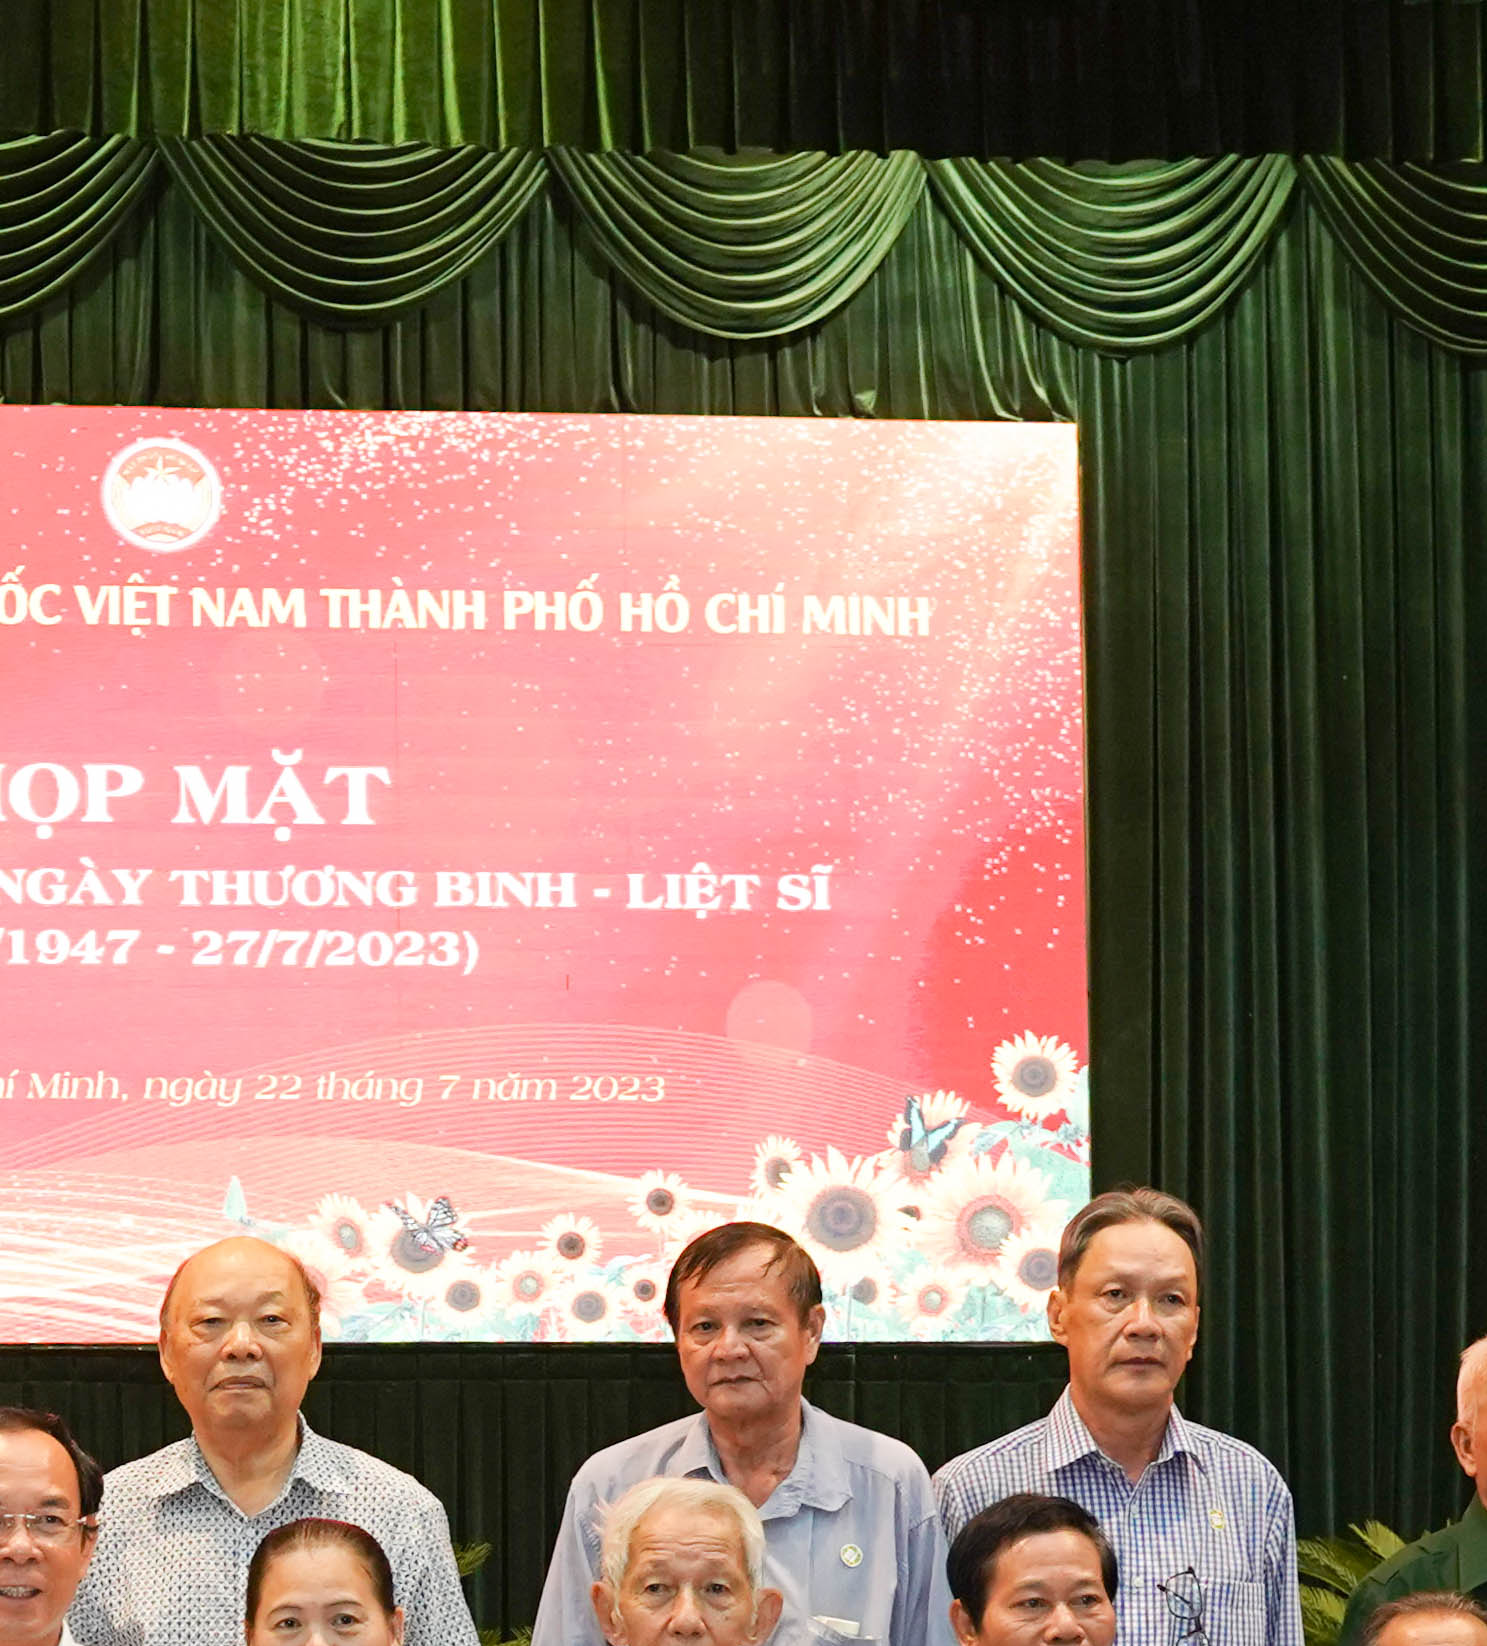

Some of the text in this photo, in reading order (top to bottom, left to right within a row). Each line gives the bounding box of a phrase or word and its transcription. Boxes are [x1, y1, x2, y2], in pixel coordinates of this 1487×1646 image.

[74, 576, 172, 637] VIỆT
[191, 587, 307, 628] NAM
[321, 576, 485, 630] THÀNH
[503, 573, 604, 632] PHỐ
[621, 574, 689, 633] HỒ
[705, 582, 787, 635] CHÍ
[803, 595, 930, 638] MINH
[171, 749, 391, 842] MẶT
[169, 865, 417, 908] THƯƠNG
[434, 871, 577, 909] BINH
[593, 887, 611, 898] -
[626, 861, 761, 920] LIỆT
[776, 864, 832, 911] SĨ
[156, 944, 175, 955] -
[191, 930, 479, 975] 27/7/2023)
[27, 1071, 129, 1102] Minh,
[143, 1070, 243, 1108] ngày
[254, 1073, 303, 1101] 22
[316, 1069, 424, 1108] tháng
[438, 1073, 461, 1100] 7
[472, 1072, 557, 1101] năm
[569, 1073, 665, 1103] 2023
